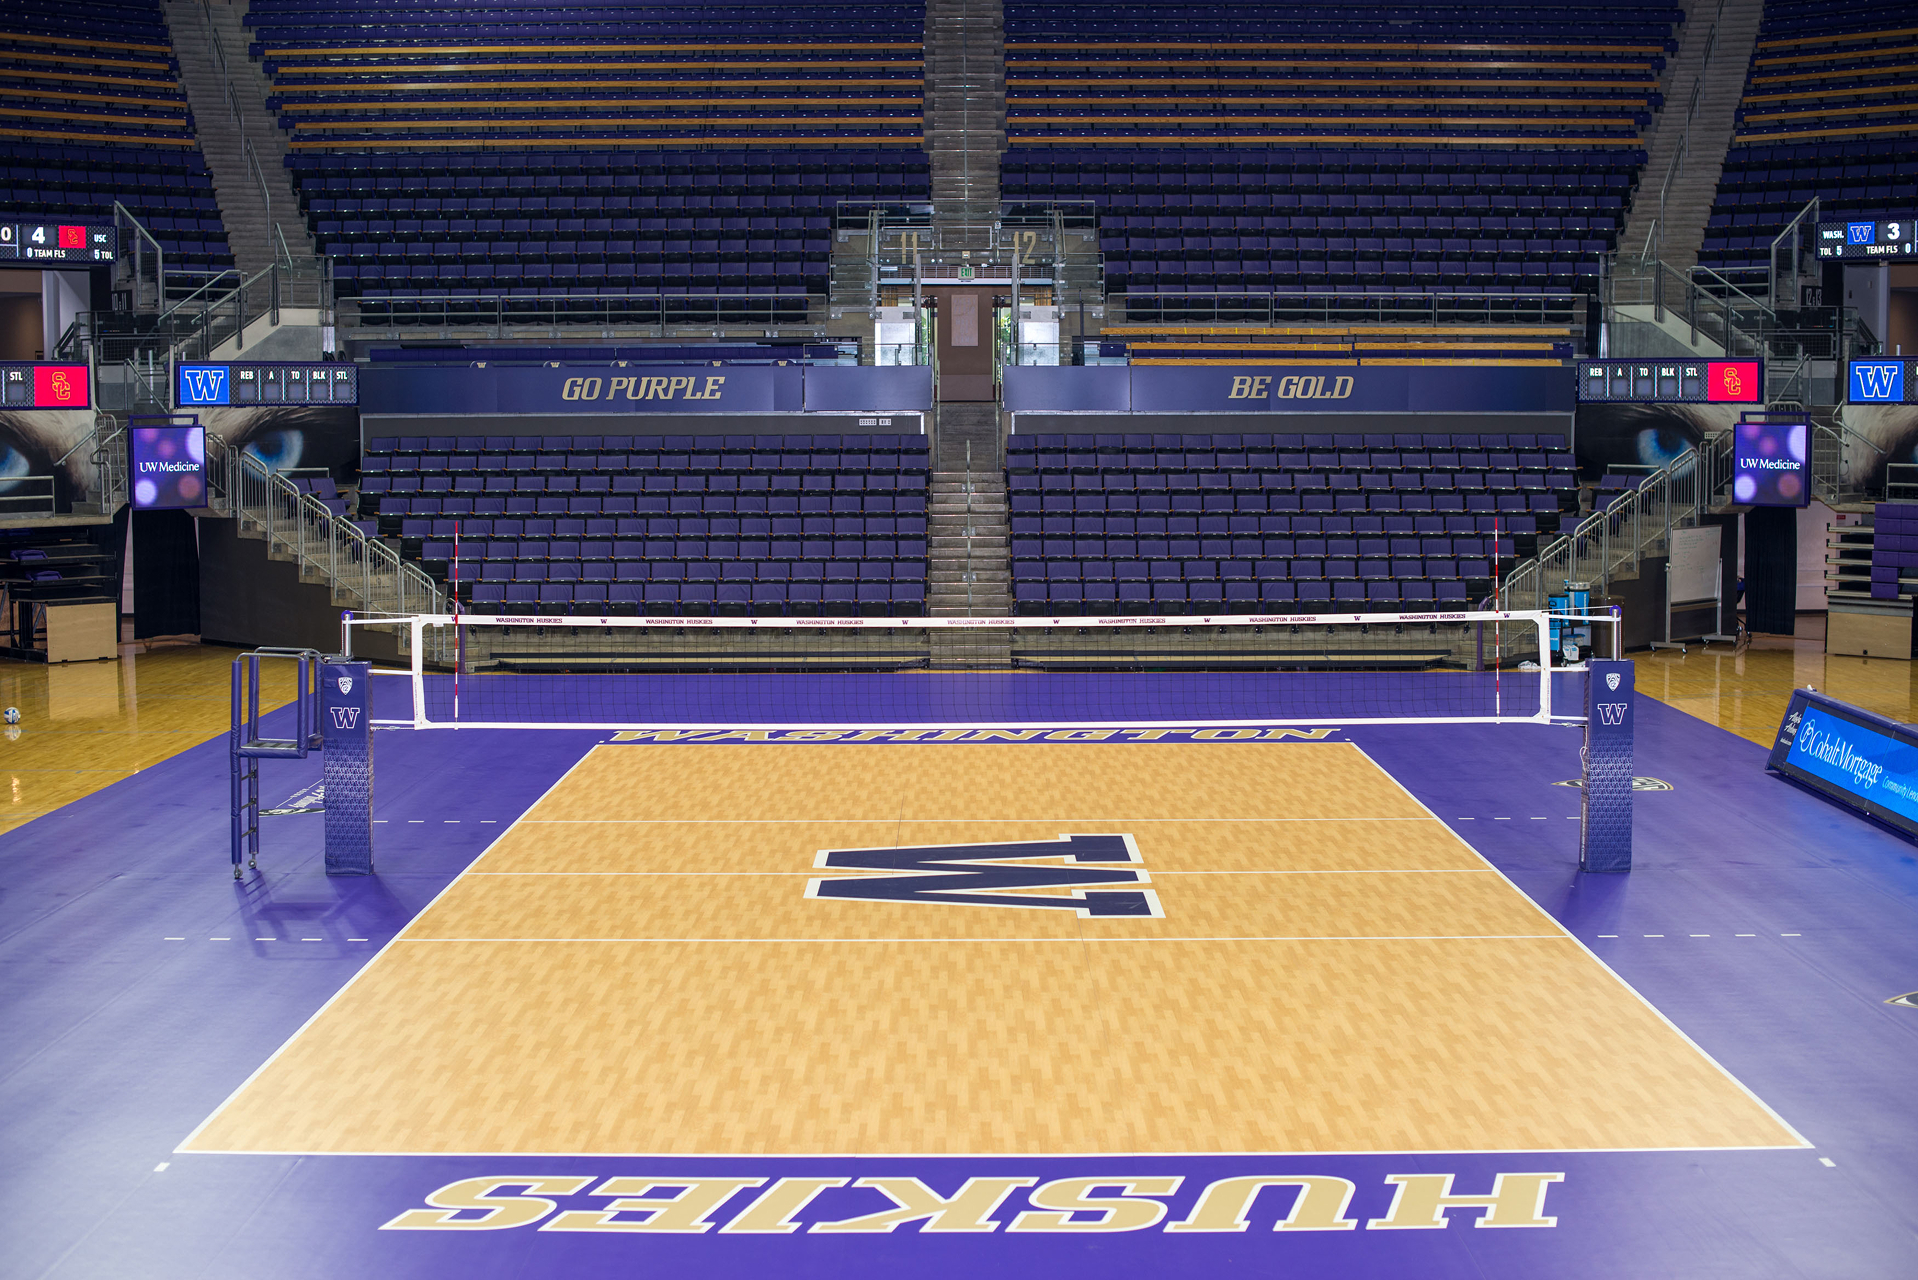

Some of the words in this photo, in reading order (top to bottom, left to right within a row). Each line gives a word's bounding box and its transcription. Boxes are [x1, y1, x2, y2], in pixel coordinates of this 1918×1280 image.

[31, 226, 46, 244] 4
[93, 234, 107, 243] USC
[1822, 230, 1844, 240] WASH.
[1850, 225, 1872, 242] W
[1887, 222, 1900, 240] 3
[26, 247, 33, 258] 0
[34, 249, 53, 258] TEAM
[54, 249, 66, 258] FLS
[94, 249, 100, 260] 5
[100, 251, 114, 260] TOL
[900, 231, 918, 265] 11
[1013, 231, 1037, 265] 12
[1819, 247, 1833, 256] TOL
[1836, 245, 1843, 256] 5
[1866, 245, 1885, 254] TEAM
[1886, 245, 1898, 254] FLS
[1904, 242, 1912, 254] 0
[960, 267, 973, 277] EXIT
[9, 371, 23, 381] STL
[240, 370, 254, 380] REB
[268, 370, 274, 380] A
[291, 370, 300, 380] TO
[312, 370, 326, 380] BLK
[336, 371, 348, 380] STL
[1589, 368, 1603, 377] REB
[1617, 368, 1622, 377] A
[1639, 368, 1648, 377] TO
[1661, 368, 1674, 377] BLK
[1685, 368, 1698, 377] STL
[185, 370, 225, 401] W
[561, 377, 603, 401] GO
[605, 376, 726, 400] PURPLE
[1228, 375, 1273, 399] BE
[1277, 375, 1355, 399] GOLD
[1855, 365, 1898, 398] W
[139, 461, 158, 472] UW
[159, 461, 200, 472] Medicine
[1740, 458, 1759, 469] UW
[1759, 458, 1801, 470] Medicine
[330, 707, 360, 729] W
[1597, 703, 1627, 725] W
[609, 727, 1343, 743] WASHINGTON
[1809, 731, 1840, 766] Cobalt
[1838, 741, 1883, 790] Mortgage
[803, 833, 1167, 919] W
[378, 1172, 1566, 1234] HUSKIES
